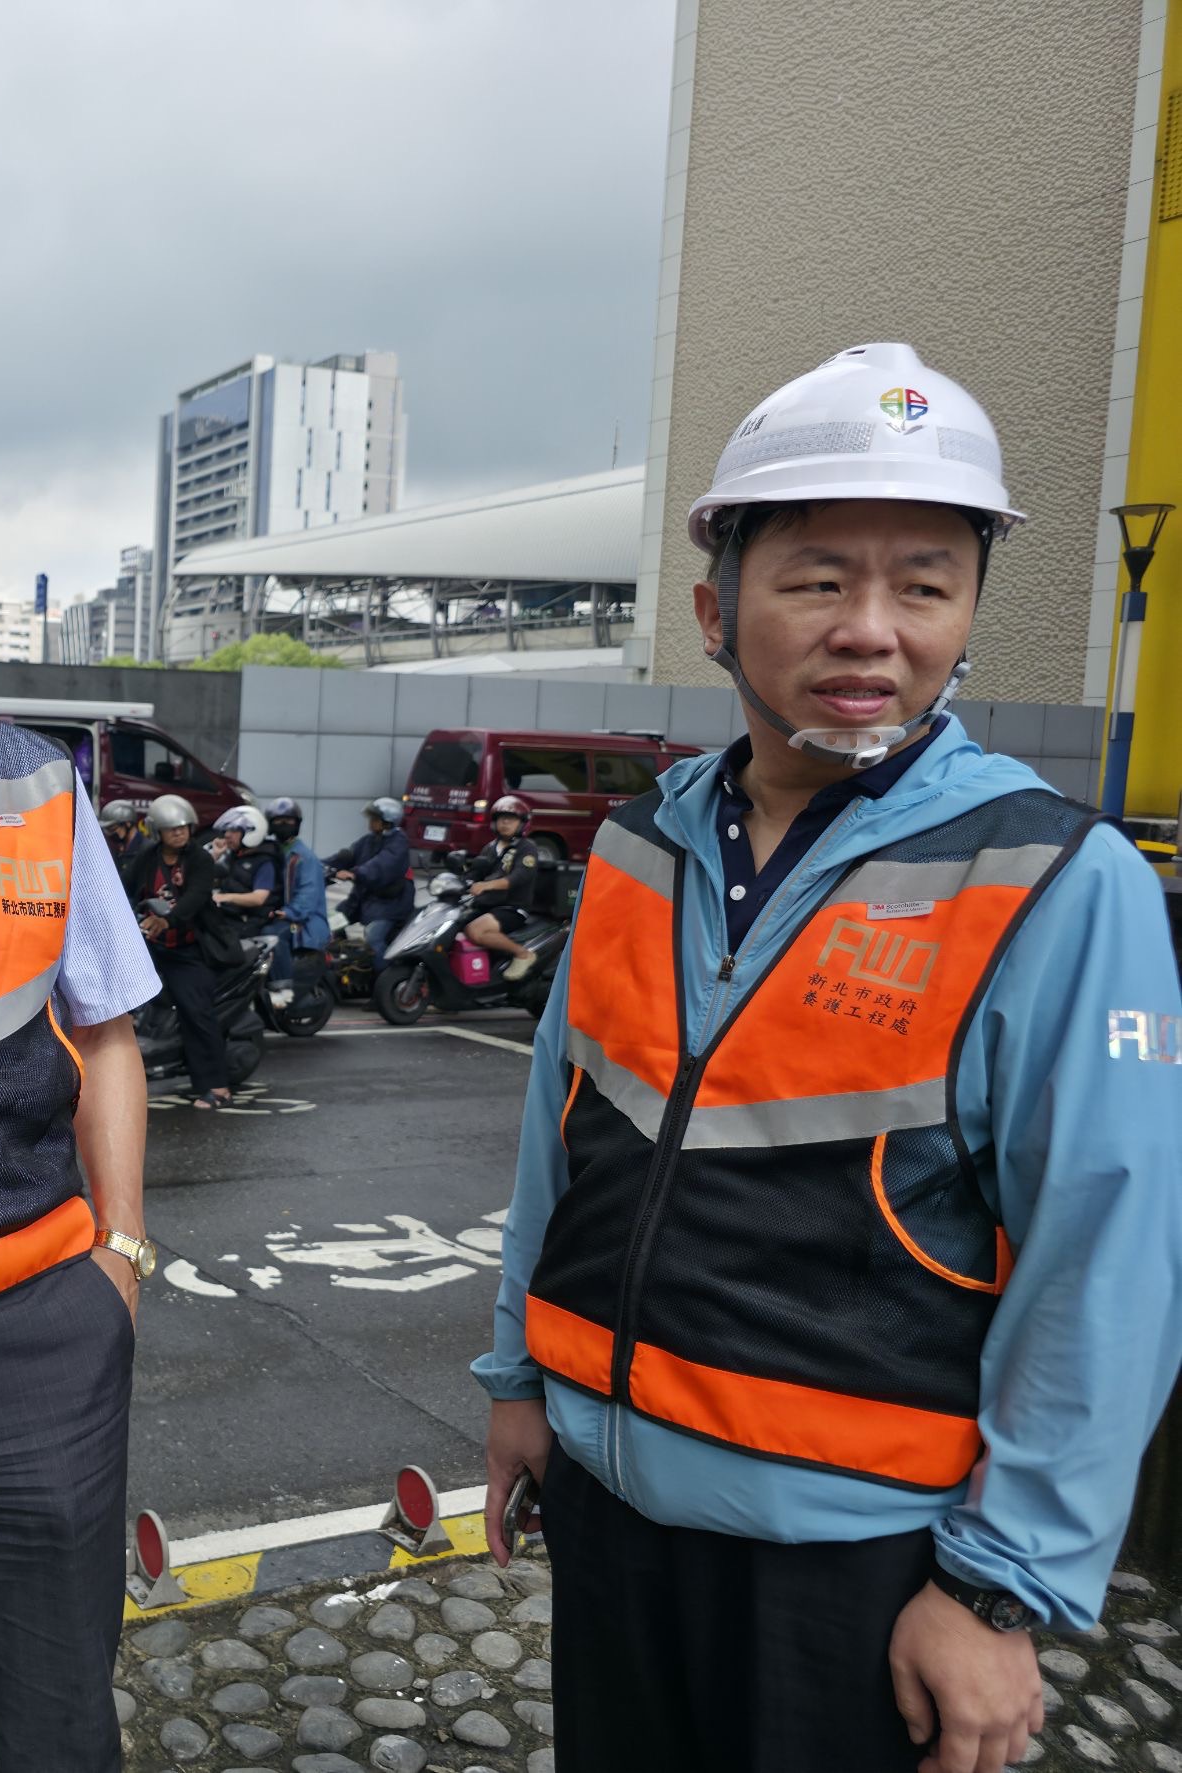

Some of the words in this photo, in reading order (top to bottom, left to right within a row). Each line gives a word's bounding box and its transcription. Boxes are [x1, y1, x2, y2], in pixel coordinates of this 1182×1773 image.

[1, 898, 66, 918] 新北市政府工務局
[802, 990, 911, 1036] 養護工程處
[808, 972, 918, 1016] 新北市政府
